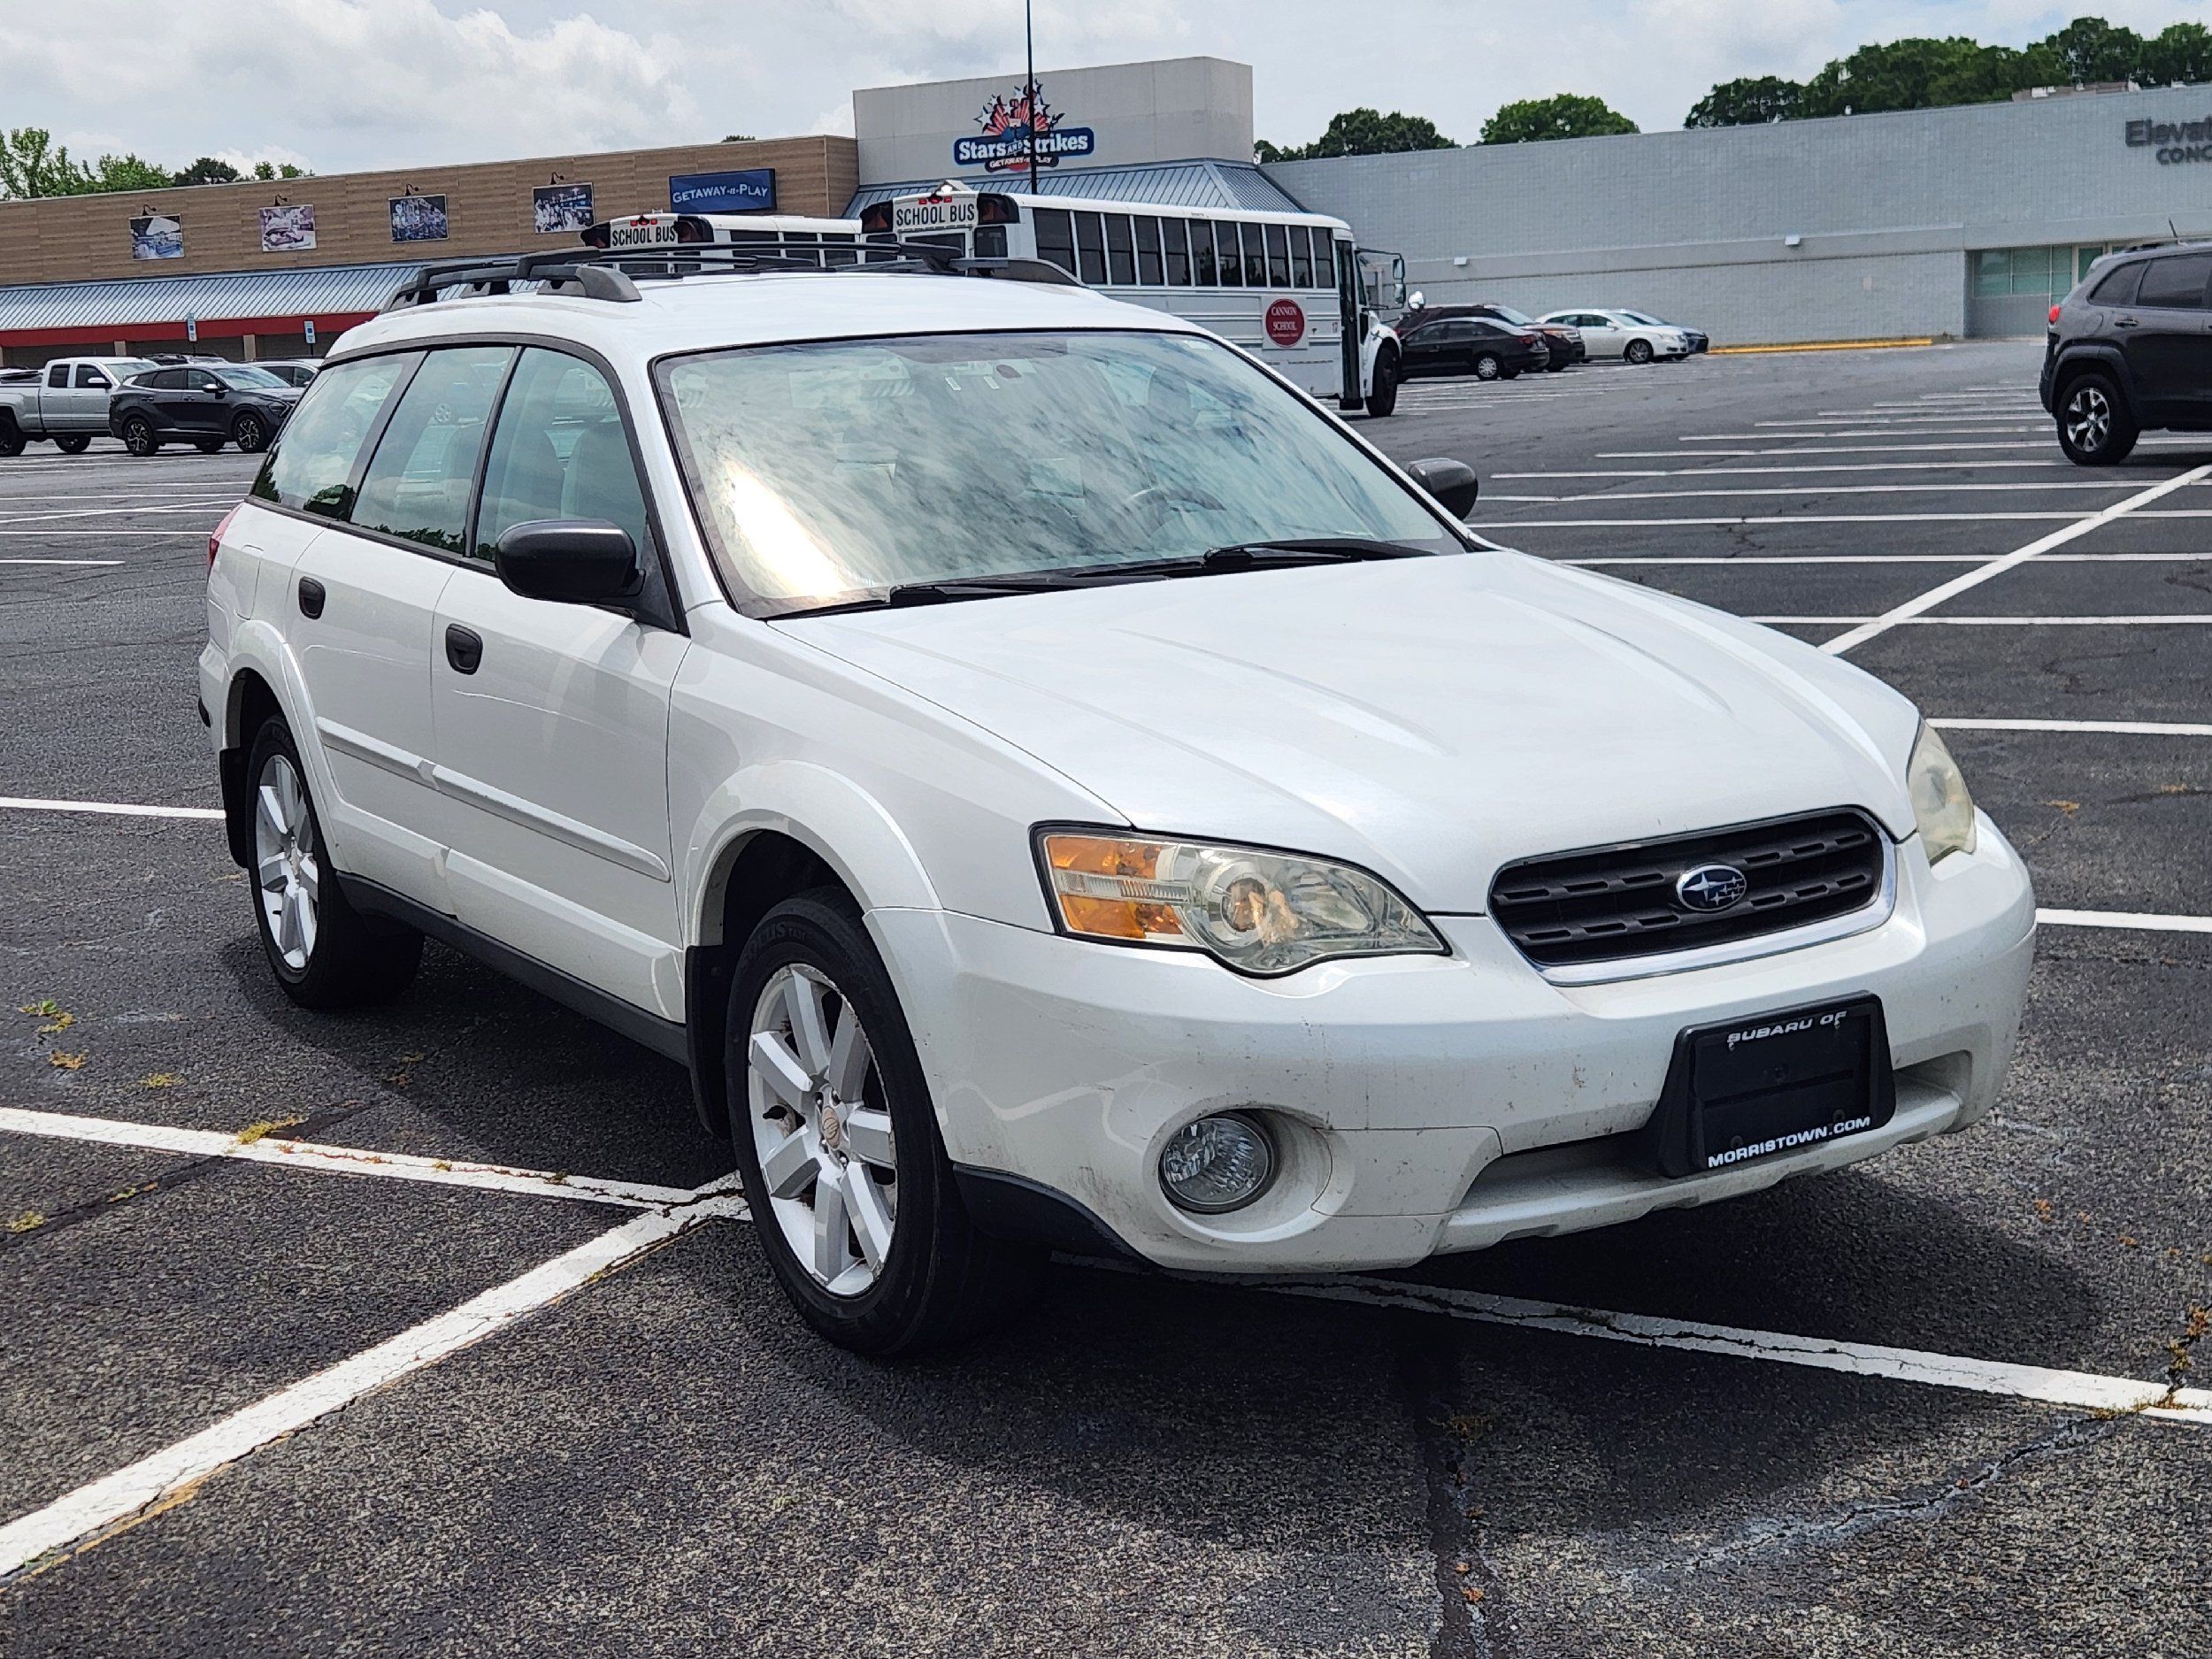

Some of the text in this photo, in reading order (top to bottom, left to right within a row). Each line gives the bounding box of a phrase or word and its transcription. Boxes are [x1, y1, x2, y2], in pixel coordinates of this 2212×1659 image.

[958, 141, 1007, 161] Stars
[1007, 142, 1023, 154] AND
[895, 204, 975, 227] SCHOOL BUS
[611, 225, 676, 247] SCHOOL BUS
[1271, 306, 1298, 317] CANNON
[1273, 321, 1298, 331] SCHOOL
[1726, 1010, 1847, 1043] SUBARU OF
[1708, 1116, 1871, 1168] MORRISTOWN.COM
